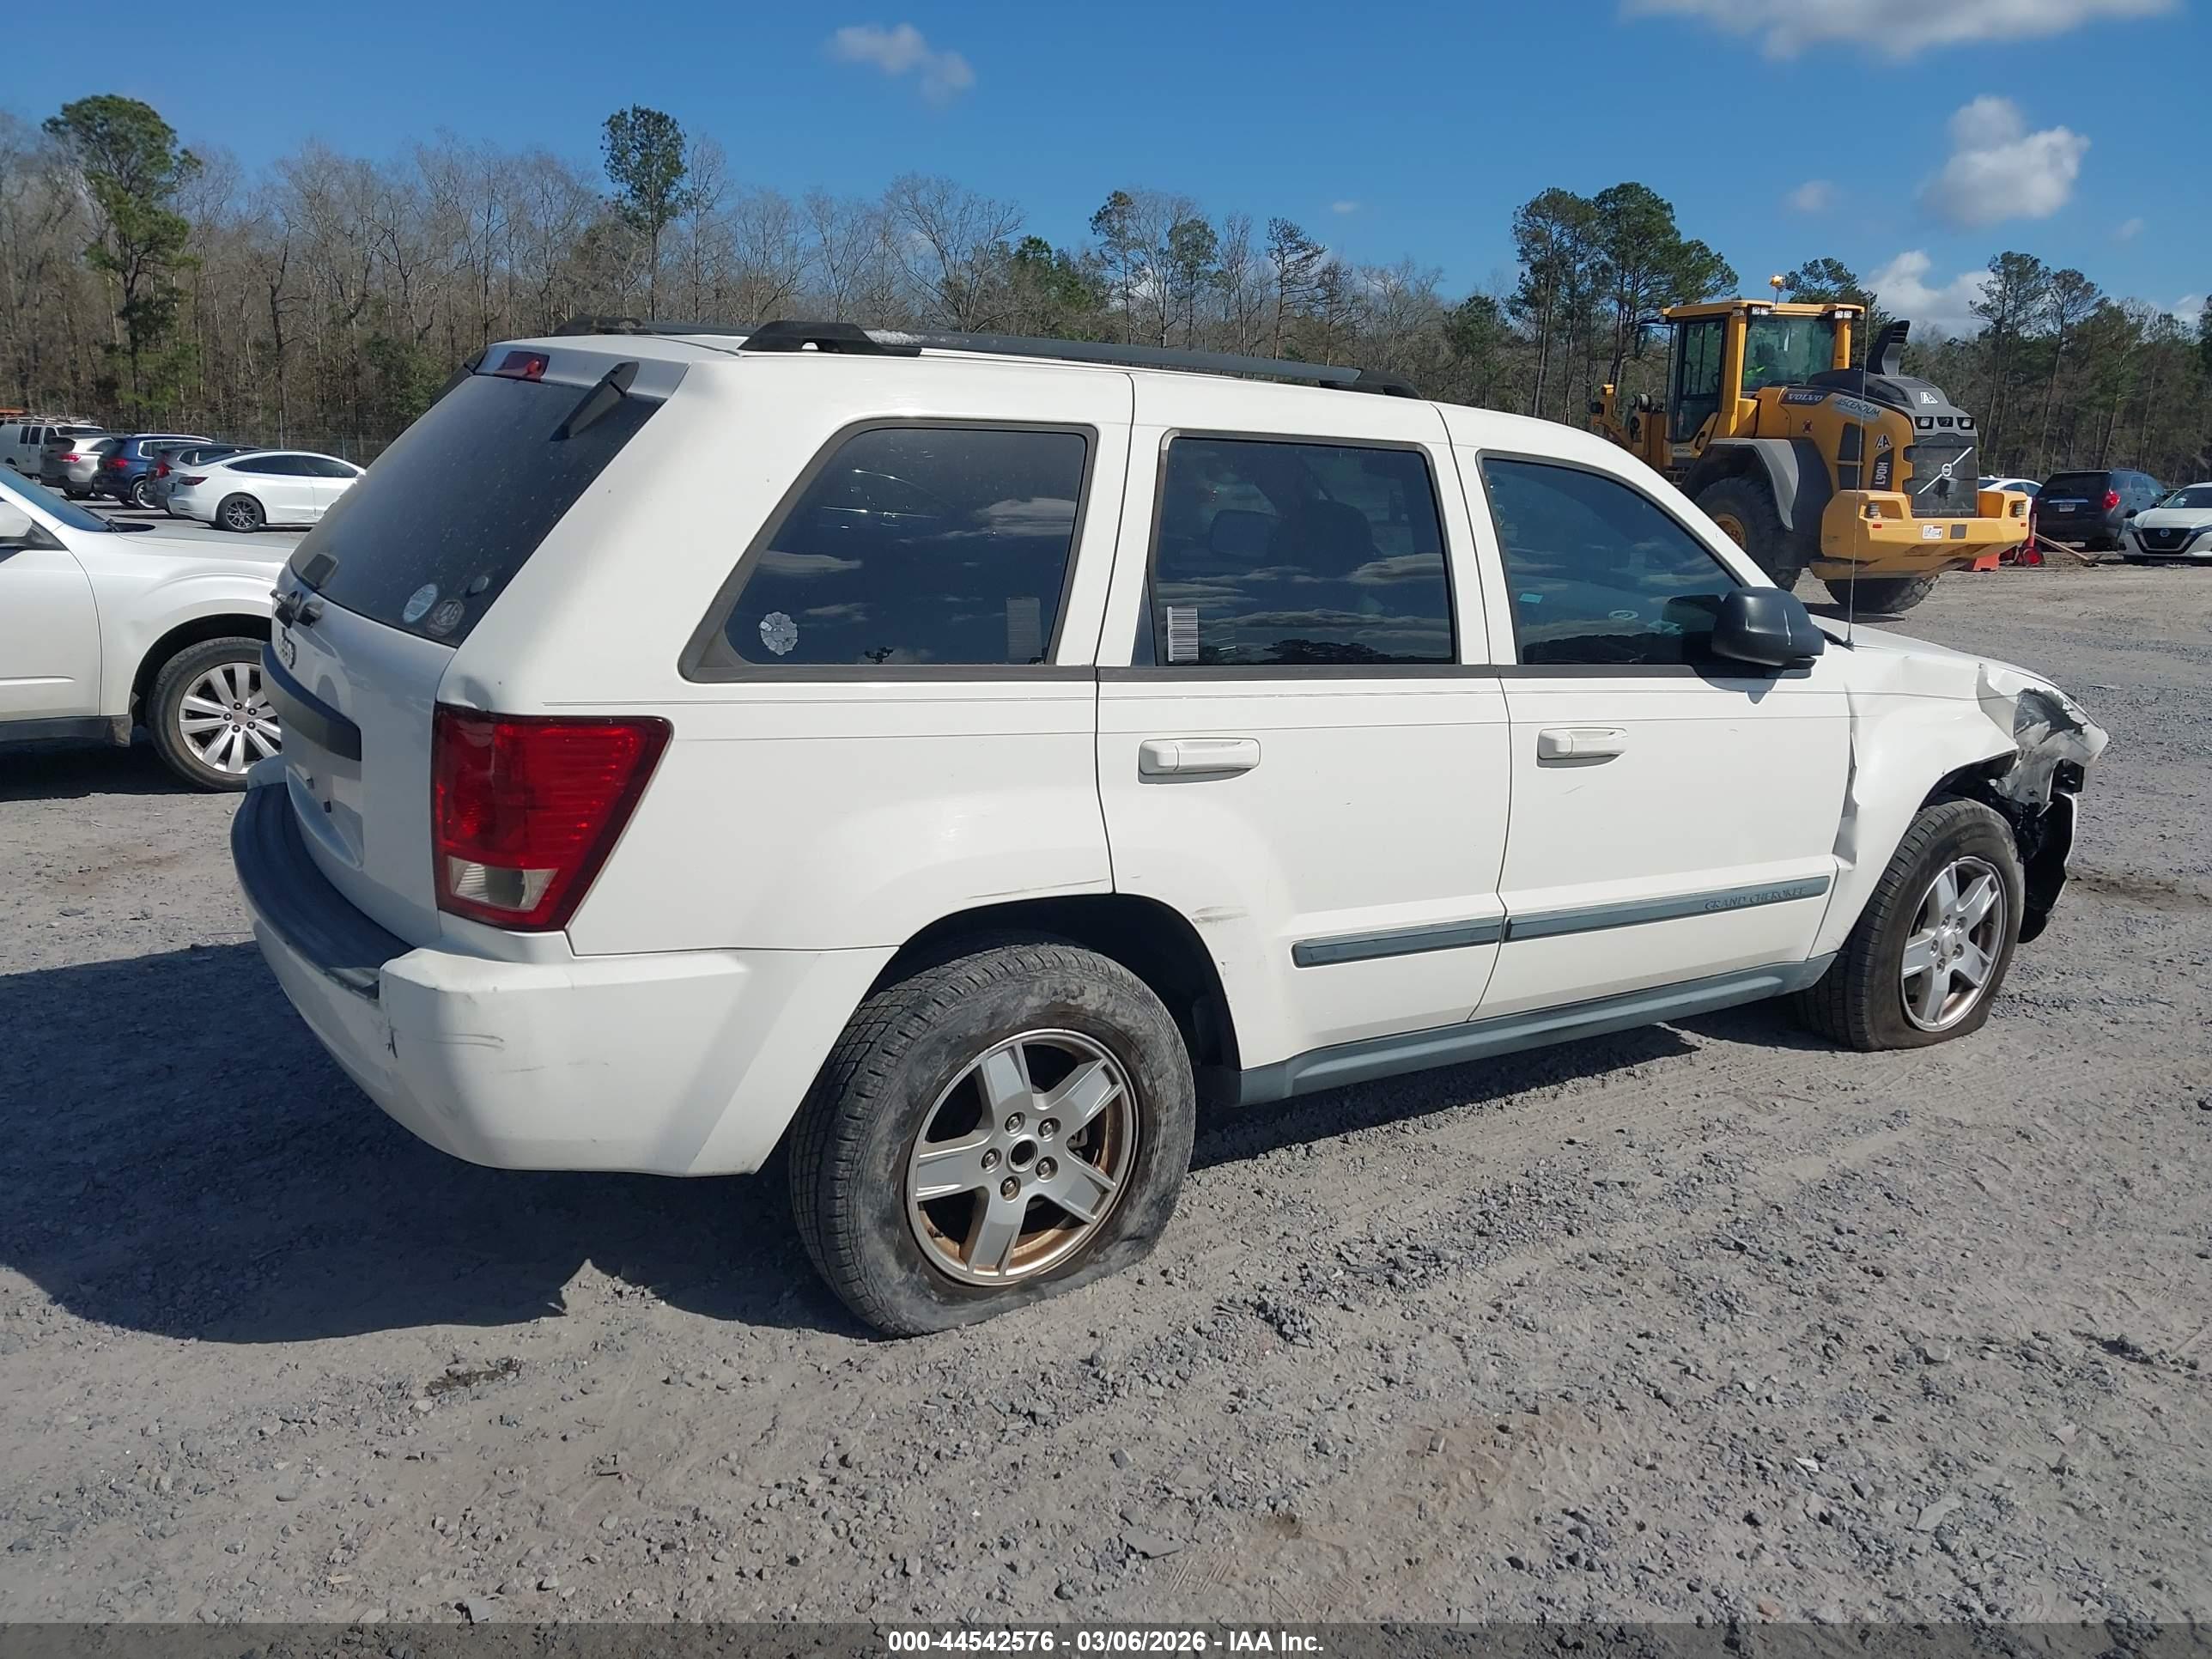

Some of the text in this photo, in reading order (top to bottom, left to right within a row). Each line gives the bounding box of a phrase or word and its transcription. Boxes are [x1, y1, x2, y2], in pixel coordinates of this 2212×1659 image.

[1875, 462, 1889, 485] L90H
[1705, 886, 1807, 910] GRAND CHEROKEE
